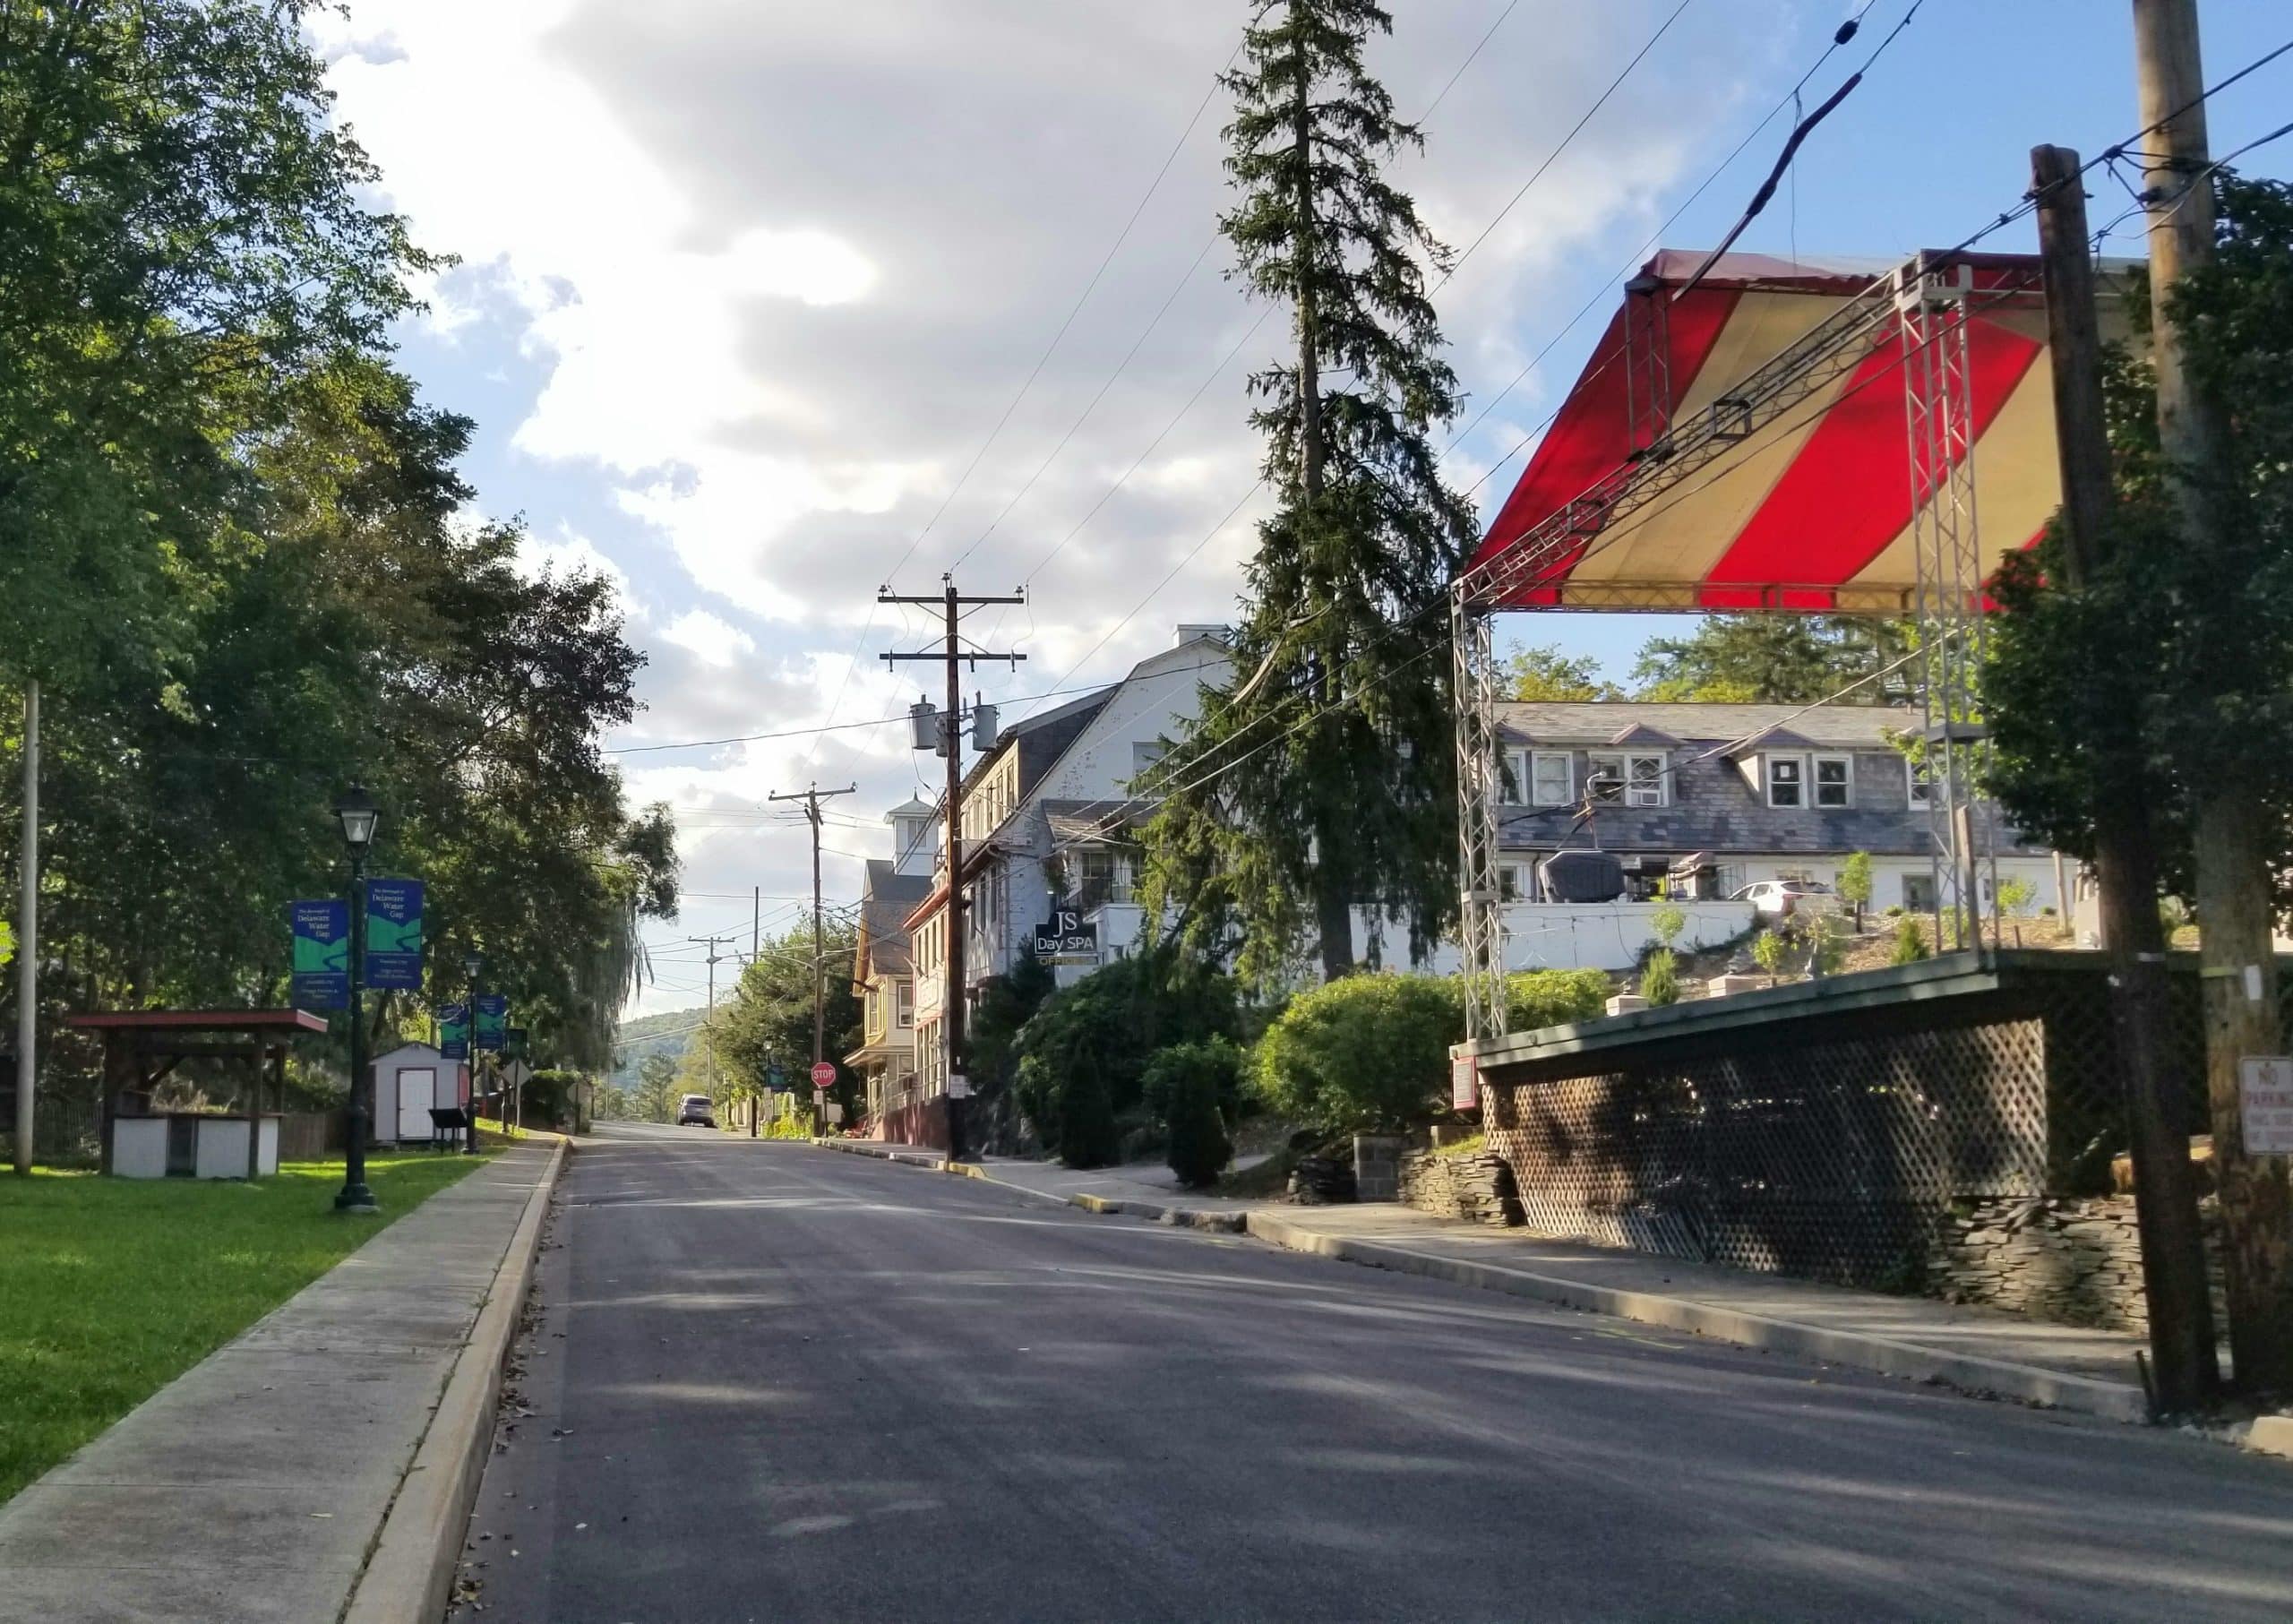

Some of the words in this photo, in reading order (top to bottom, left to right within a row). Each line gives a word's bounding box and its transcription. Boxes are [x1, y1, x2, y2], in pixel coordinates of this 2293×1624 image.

[297, 915, 330, 923] Delaware
[1053, 912, 1078, 938] JS
[1037, 937, 1063, 956] Day
[1067, 937, 1094, 949] SPA
[813, 1069, 834, 1079] STOP
[2258, 1067, 2279, 1086] NO
